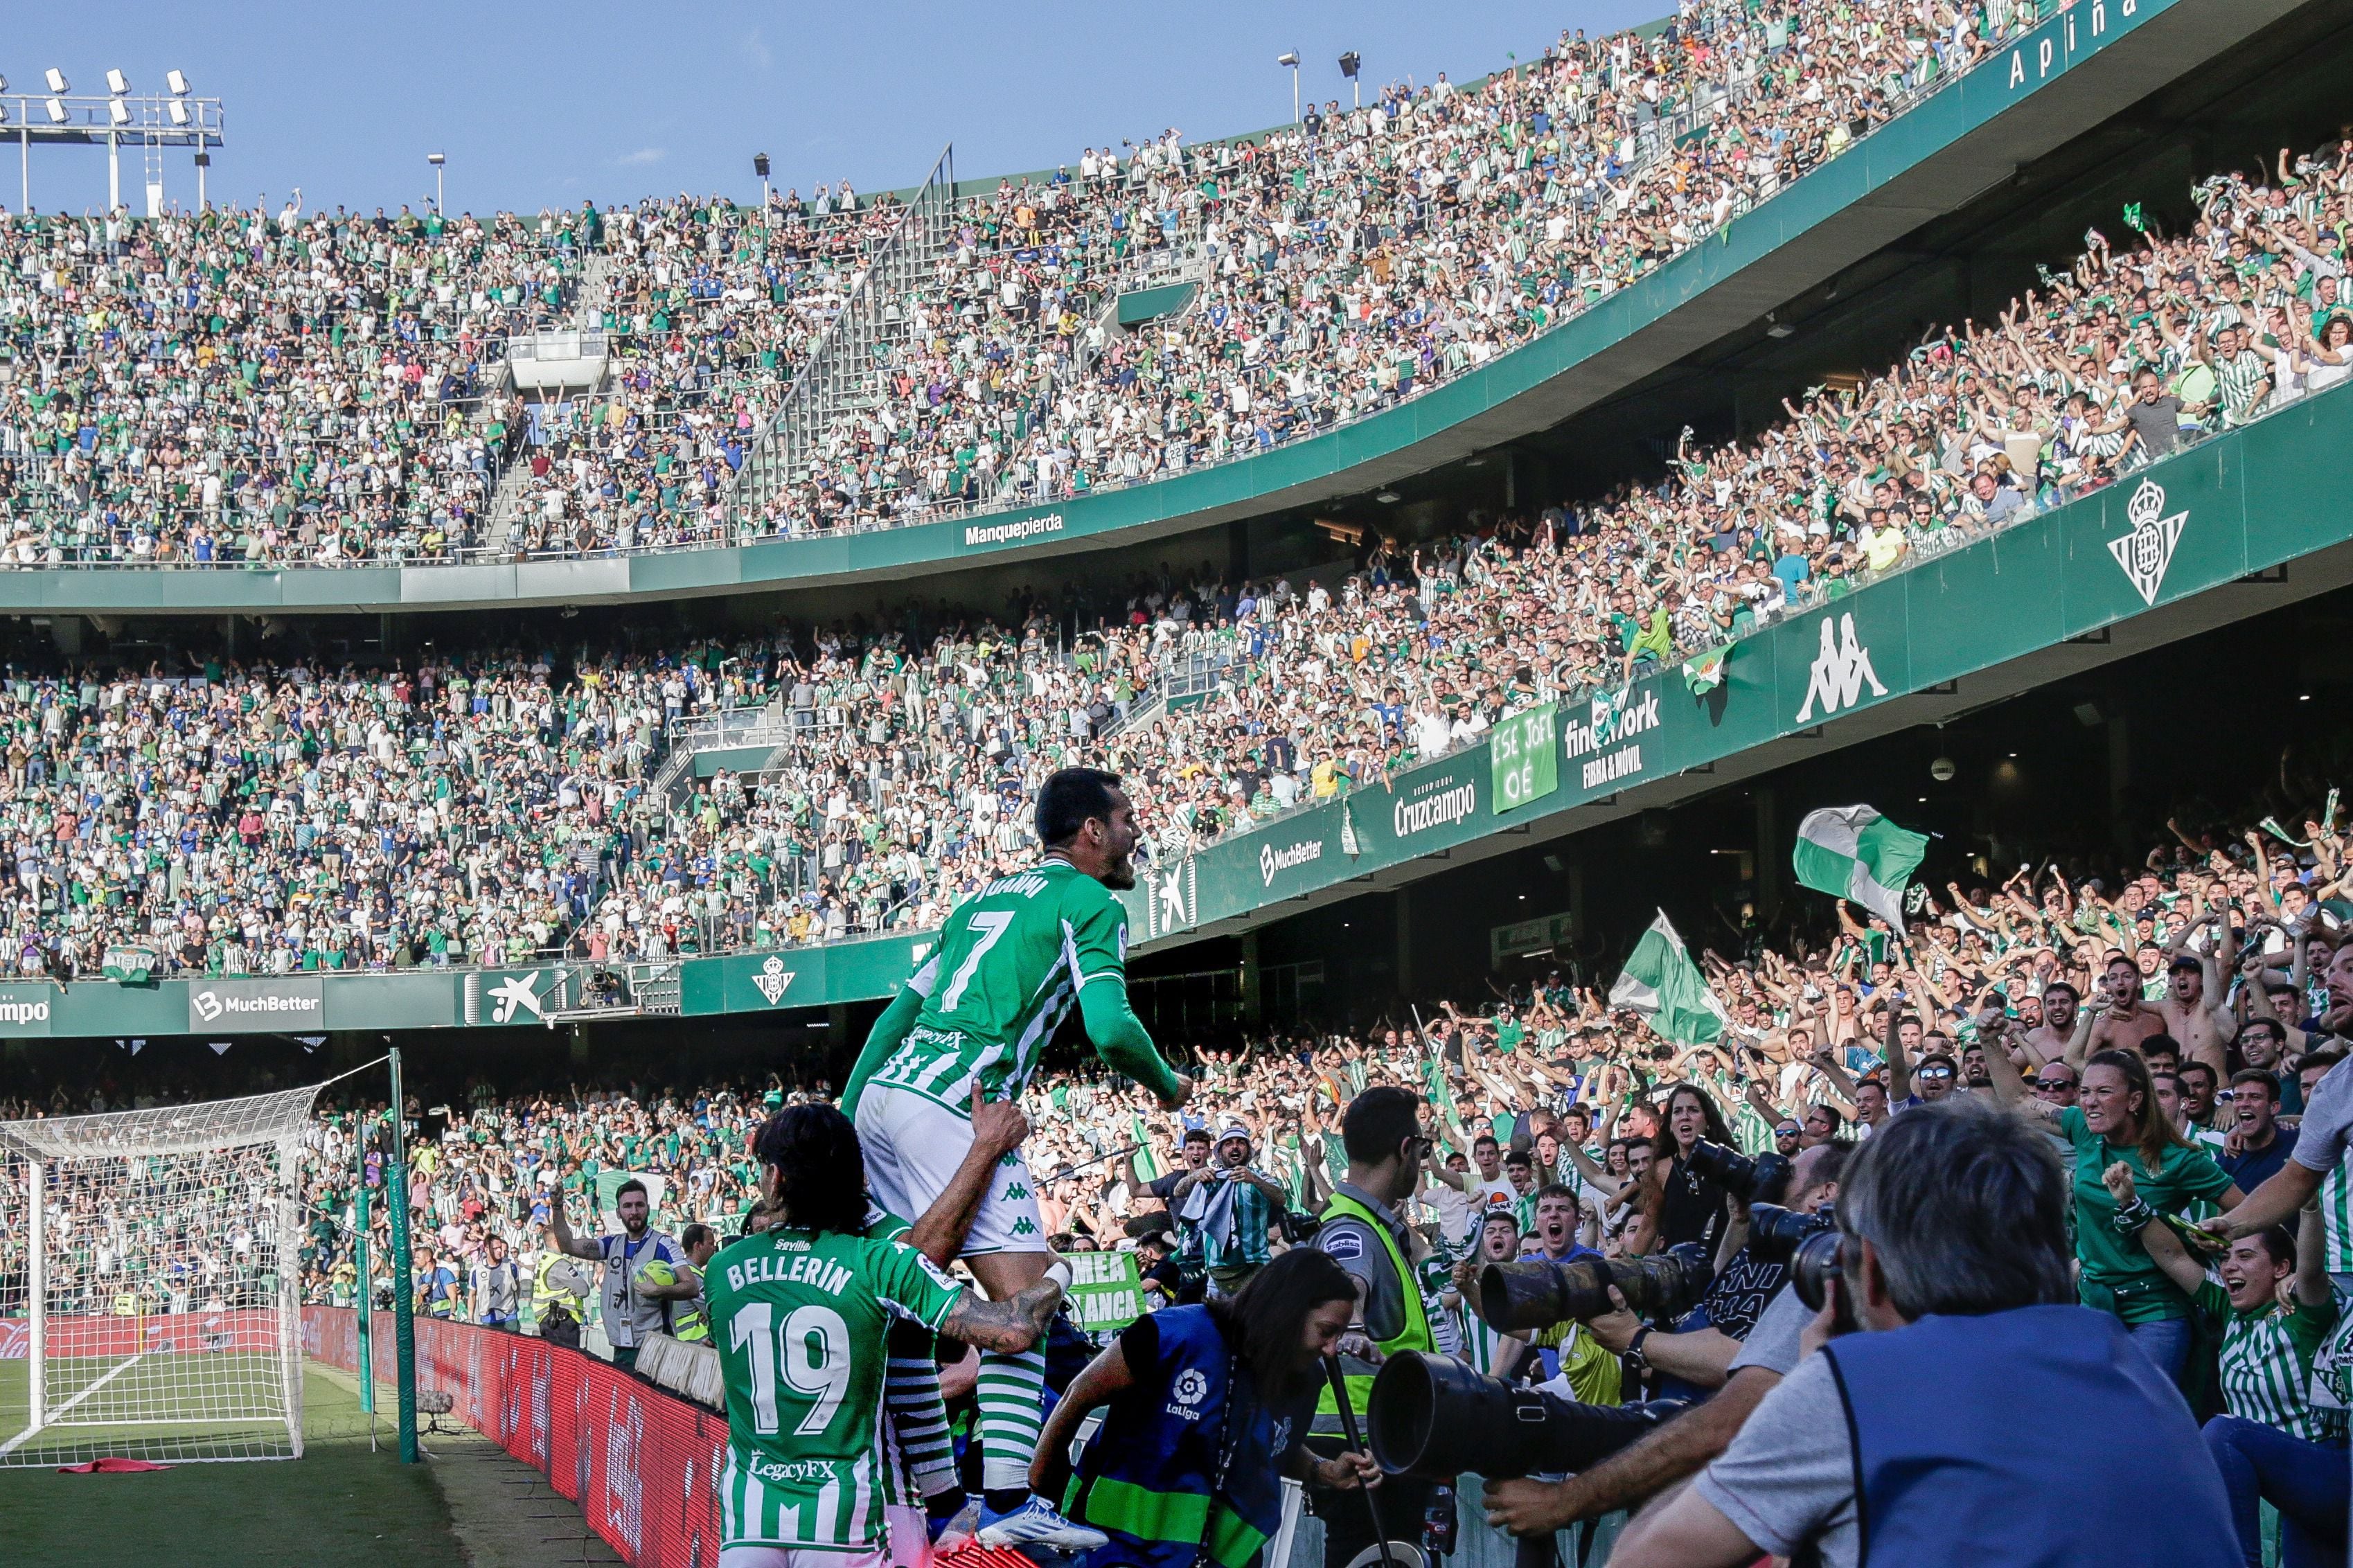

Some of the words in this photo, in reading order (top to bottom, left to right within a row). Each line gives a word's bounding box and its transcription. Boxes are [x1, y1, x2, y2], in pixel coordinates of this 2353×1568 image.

[966, 513, 1063, 545] Manquepierda
[1493, 725, 1518, 764] ESE
[1583, 758, 1608, 790] FIBRA
[1608, 755, 1615, 781] &
[1615, 745, 1642, 778] MÓVIL
[1394, 783, 1475, 837] Cruzcampo
[1275, 840, 1322, 871] MuchBetter
[938, 911, 1015, 1013] 7
[225, 996, 319, 1013] MuchBetter
[727, 1256, 853, 1297] BELLERÍN
[729, 1303, 851, 1436] 19
[1166, 1403, 1200, 1420] LaLiga
[749, 1456, 837, 1482] LegacyFX
